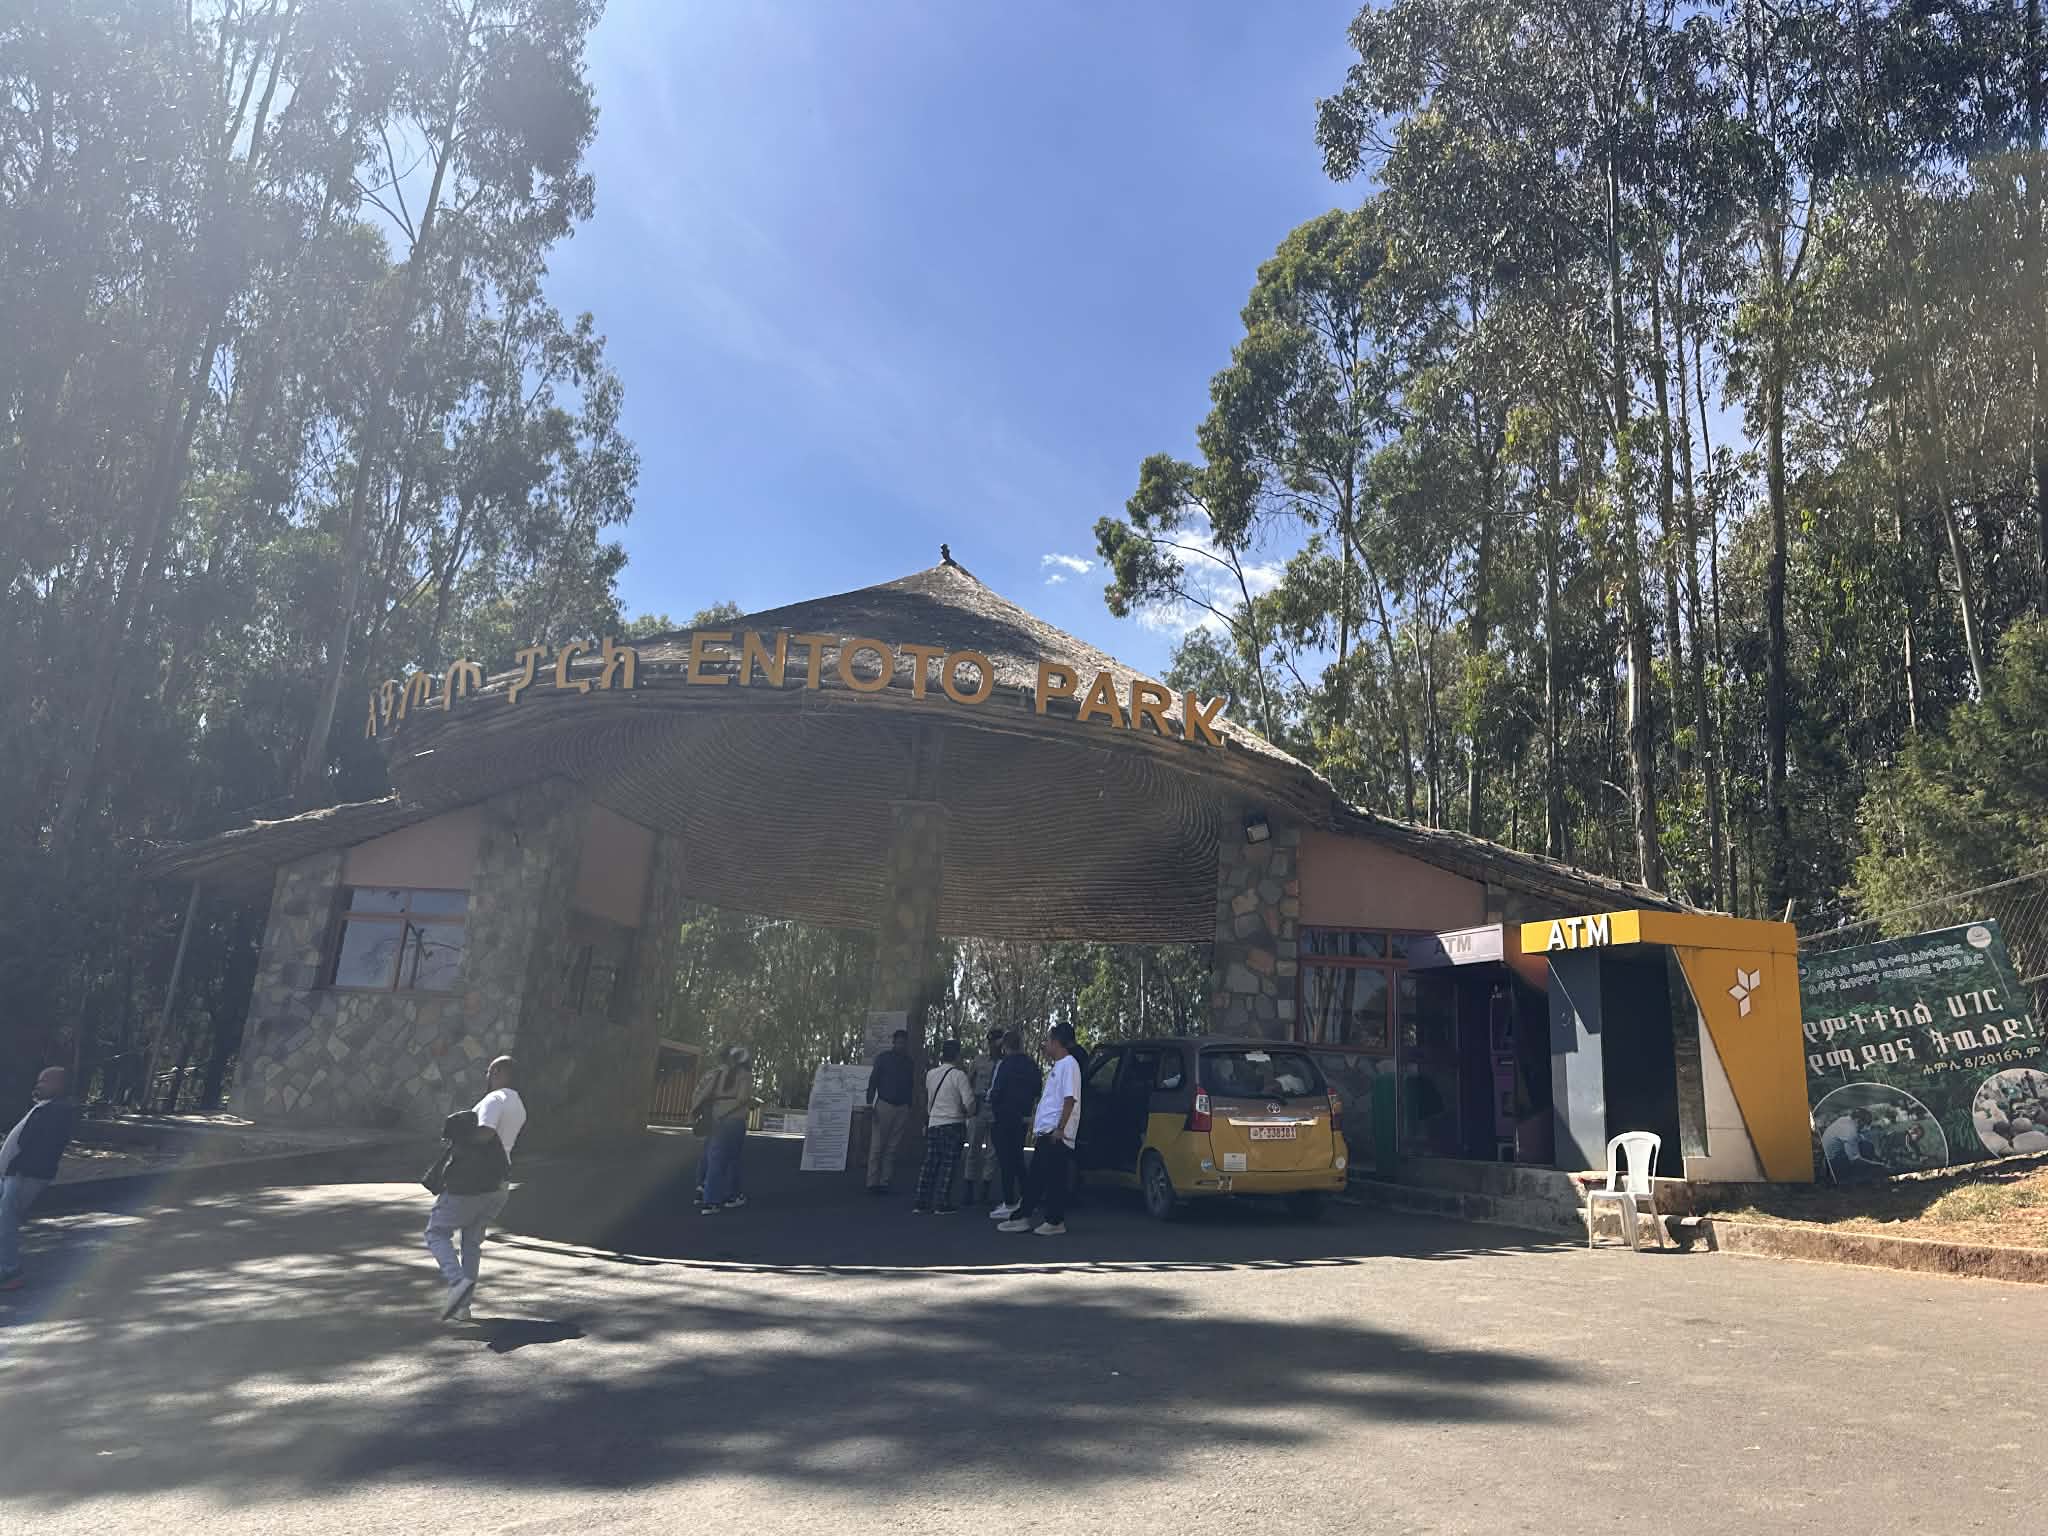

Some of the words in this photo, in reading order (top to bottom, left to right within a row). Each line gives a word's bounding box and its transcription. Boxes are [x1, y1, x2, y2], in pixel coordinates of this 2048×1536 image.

[510, 637, 636, 704] ፓርክ
[687, 629, 994, 704] ENTOTO
[1035, 661, 1226, 747] PARK
[1435, 934, 1472, 954] ATM
[1548, 914, 1610, 951] ATM
[1802, 1002, 1933, 1043] የምትተክል
[1947, 987, 2004, 1018] ሀገር
